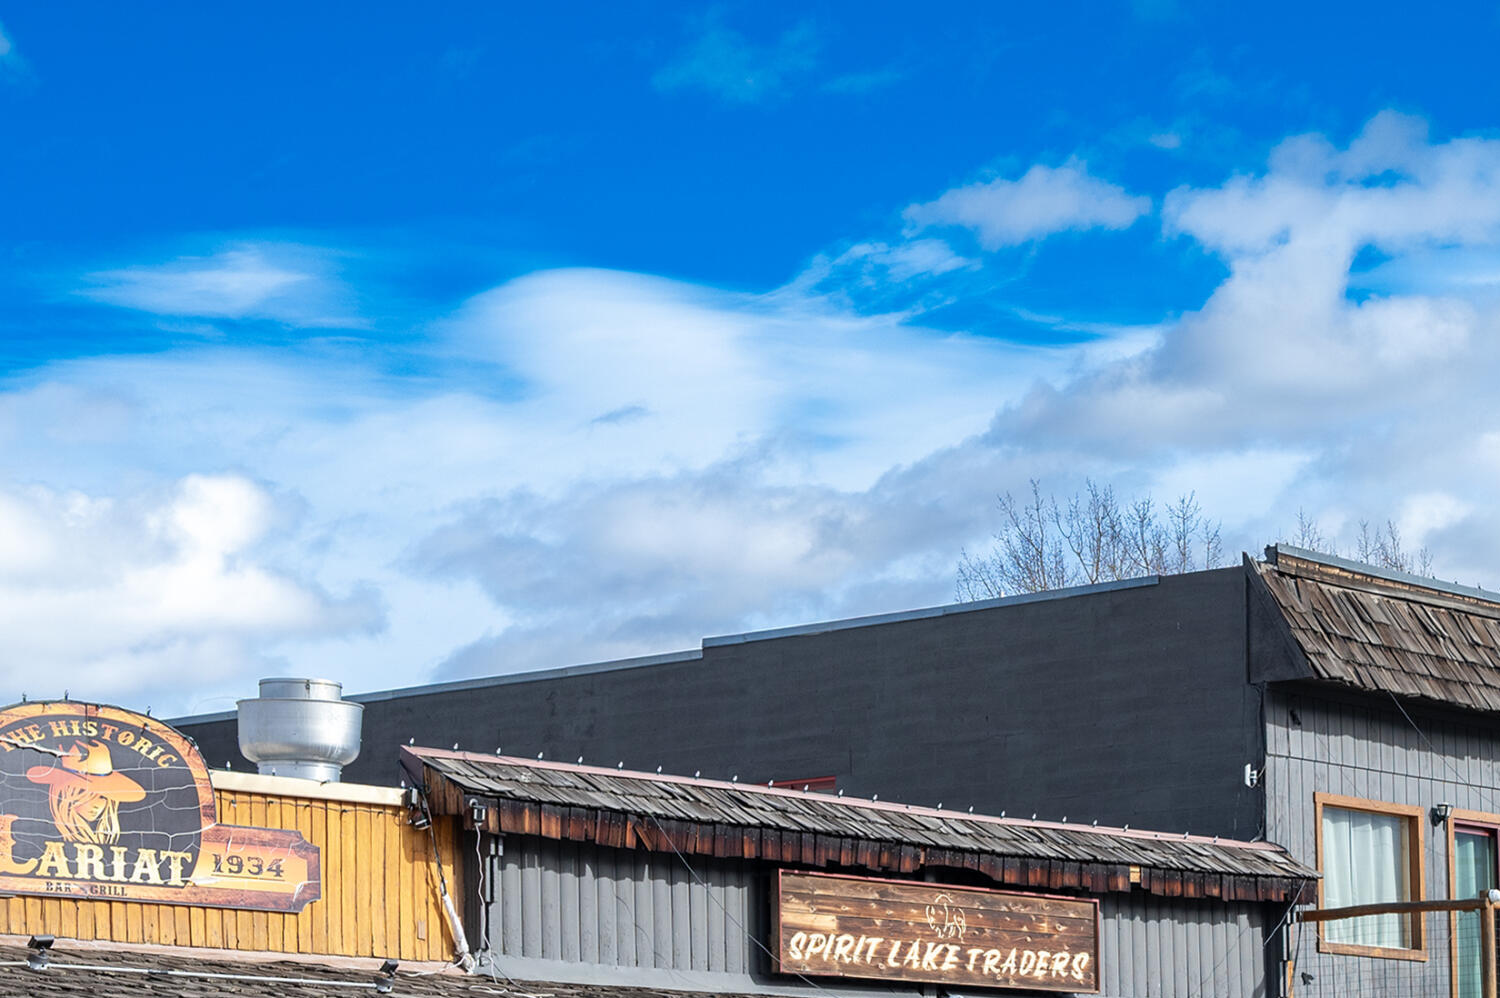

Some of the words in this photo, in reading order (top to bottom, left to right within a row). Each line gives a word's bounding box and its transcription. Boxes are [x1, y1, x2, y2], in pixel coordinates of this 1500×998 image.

[48, 719, 179, 769] HISTORIC
[0, 813, 193, 887] LARIAT
[212, 852, 285, 878] 1934
[89, 883, 128, 897] GRILL
[788, 932, 885, 963] SPIRIT
[887, 938, 962, 971] LAKE
[966, 947, 1090, 980] TRADERS
